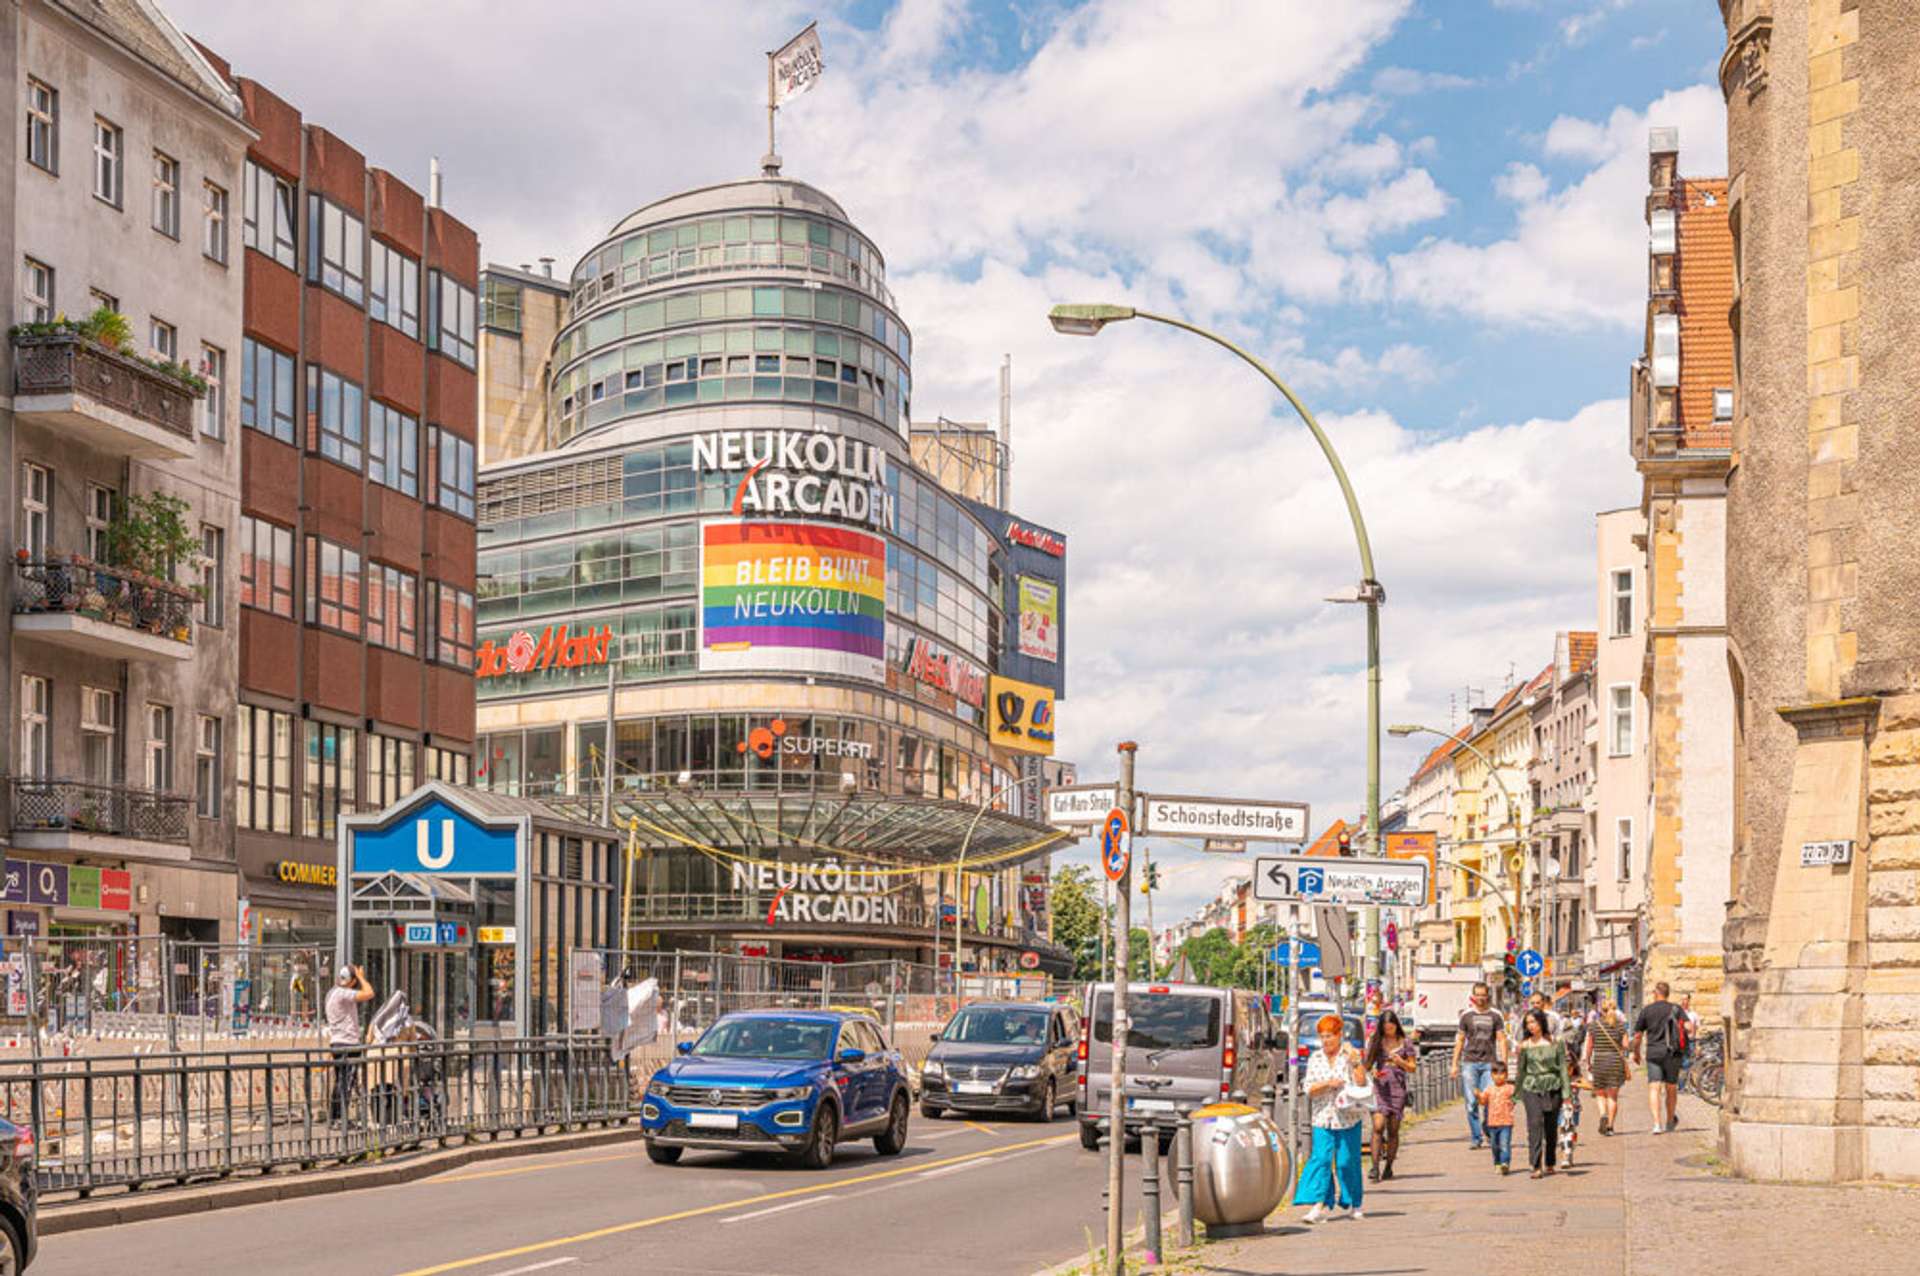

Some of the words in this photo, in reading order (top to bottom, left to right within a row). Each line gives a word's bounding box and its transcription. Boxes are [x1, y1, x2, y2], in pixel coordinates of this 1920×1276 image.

[692, 424, 888, 486] NEUKÖLLN
[732, 458, 894, 530] ARCADEN
[736, 556, 811, 586] BLEIB
[734, 586, 860, 619] NEUKÖLLN
[1157, 804, 1294, 832] Schönstedtstraße
[417, 819, 454, 869] U
[733, 857, 889, 892] NEUKÖLLN
[767, 886, 899, 926] ARCADEN
[410, 927, 432, 941] U7
